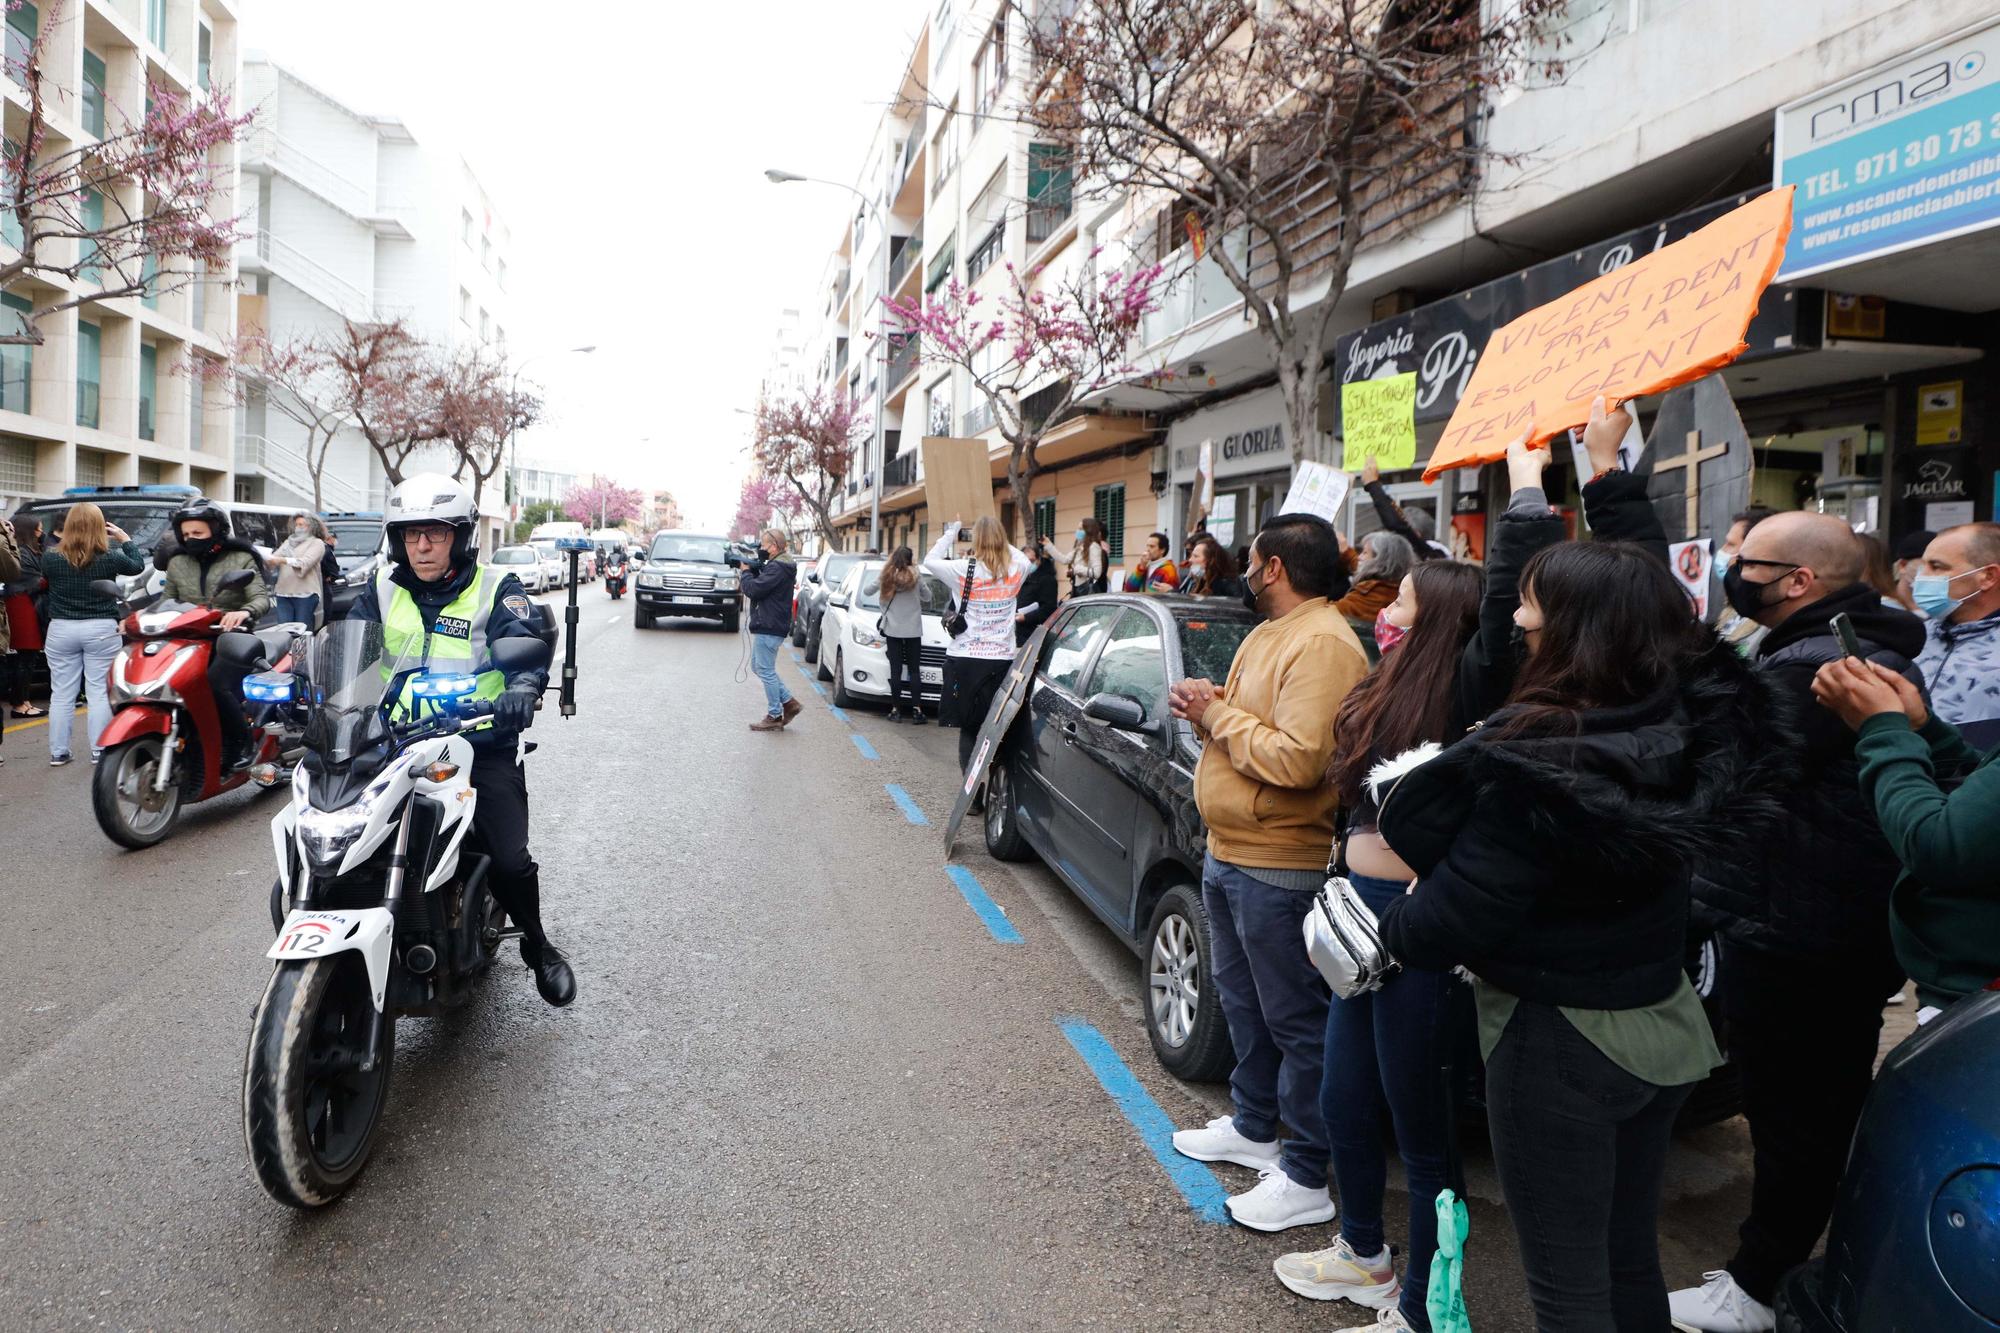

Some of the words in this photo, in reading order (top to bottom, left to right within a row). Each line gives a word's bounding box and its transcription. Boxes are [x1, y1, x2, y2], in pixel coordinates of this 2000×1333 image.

[1804, 168, 1849, 200] TEL.
[1855, 148, 1898, 184] 971
[1904, 134, 1940, 168] 30
[1947, 119, 1982, 153] 73
[1501, 268, 1649, 354] VICENT
[1471, 336, 1612, 409] ESCOLTA
[1647, 308, 1669, 329] A
[1696, 272, 1742, 311] LA
[1447, 400, 1537, 447] TEVA
[1565, 313, 1721, 400] GENT
[1223, 423, 1285, 460] GLORIA
[1903, 480, 1967, 499] JAGUAR
[436, 617, 468, 629] POLICIA
[444, 626, 467, 637] LOCAL
[279, 933, 325, 953] 112
